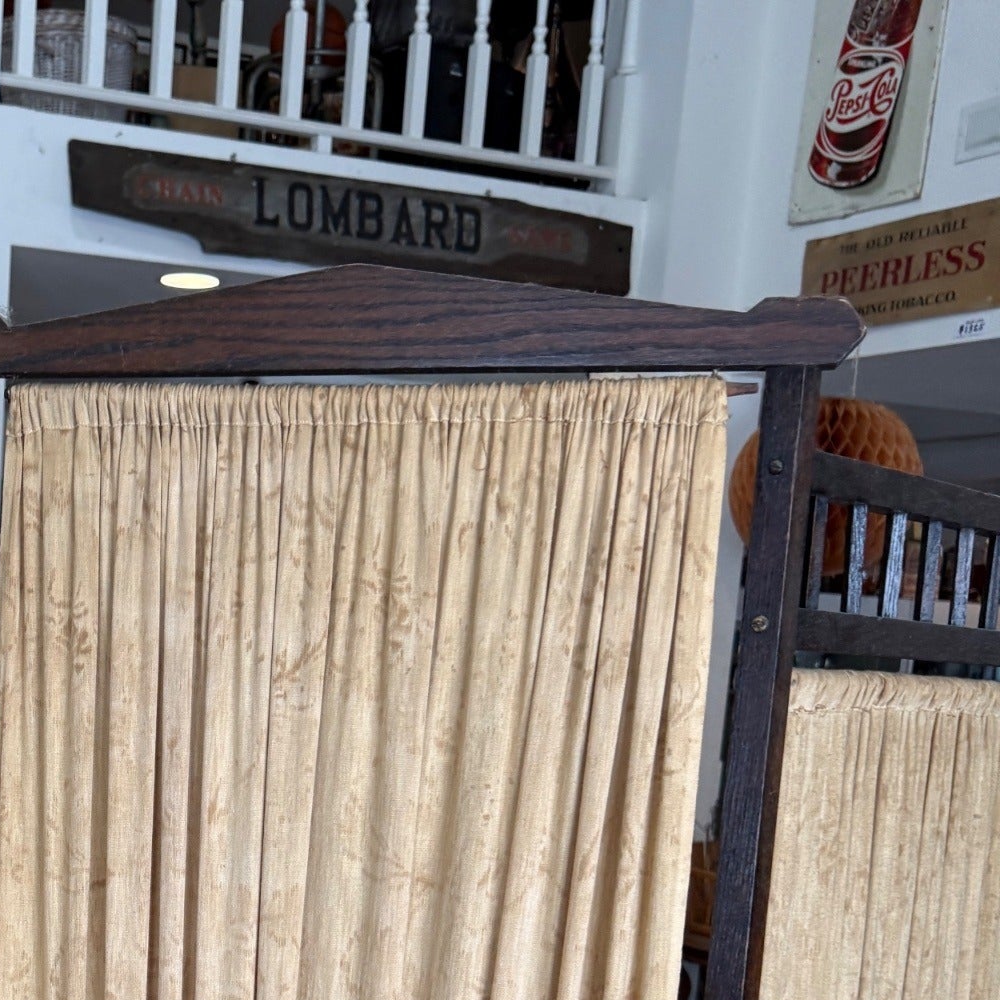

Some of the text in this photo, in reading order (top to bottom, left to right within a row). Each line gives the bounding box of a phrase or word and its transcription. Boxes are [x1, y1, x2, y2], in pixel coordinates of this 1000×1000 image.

[252, 176, 483, 254] LOMBARD
[865, 235, 893, 250] OLD
[820, 239, 987, 296] PEERLESS
[889, 290, 956, 313] TOBACCO
